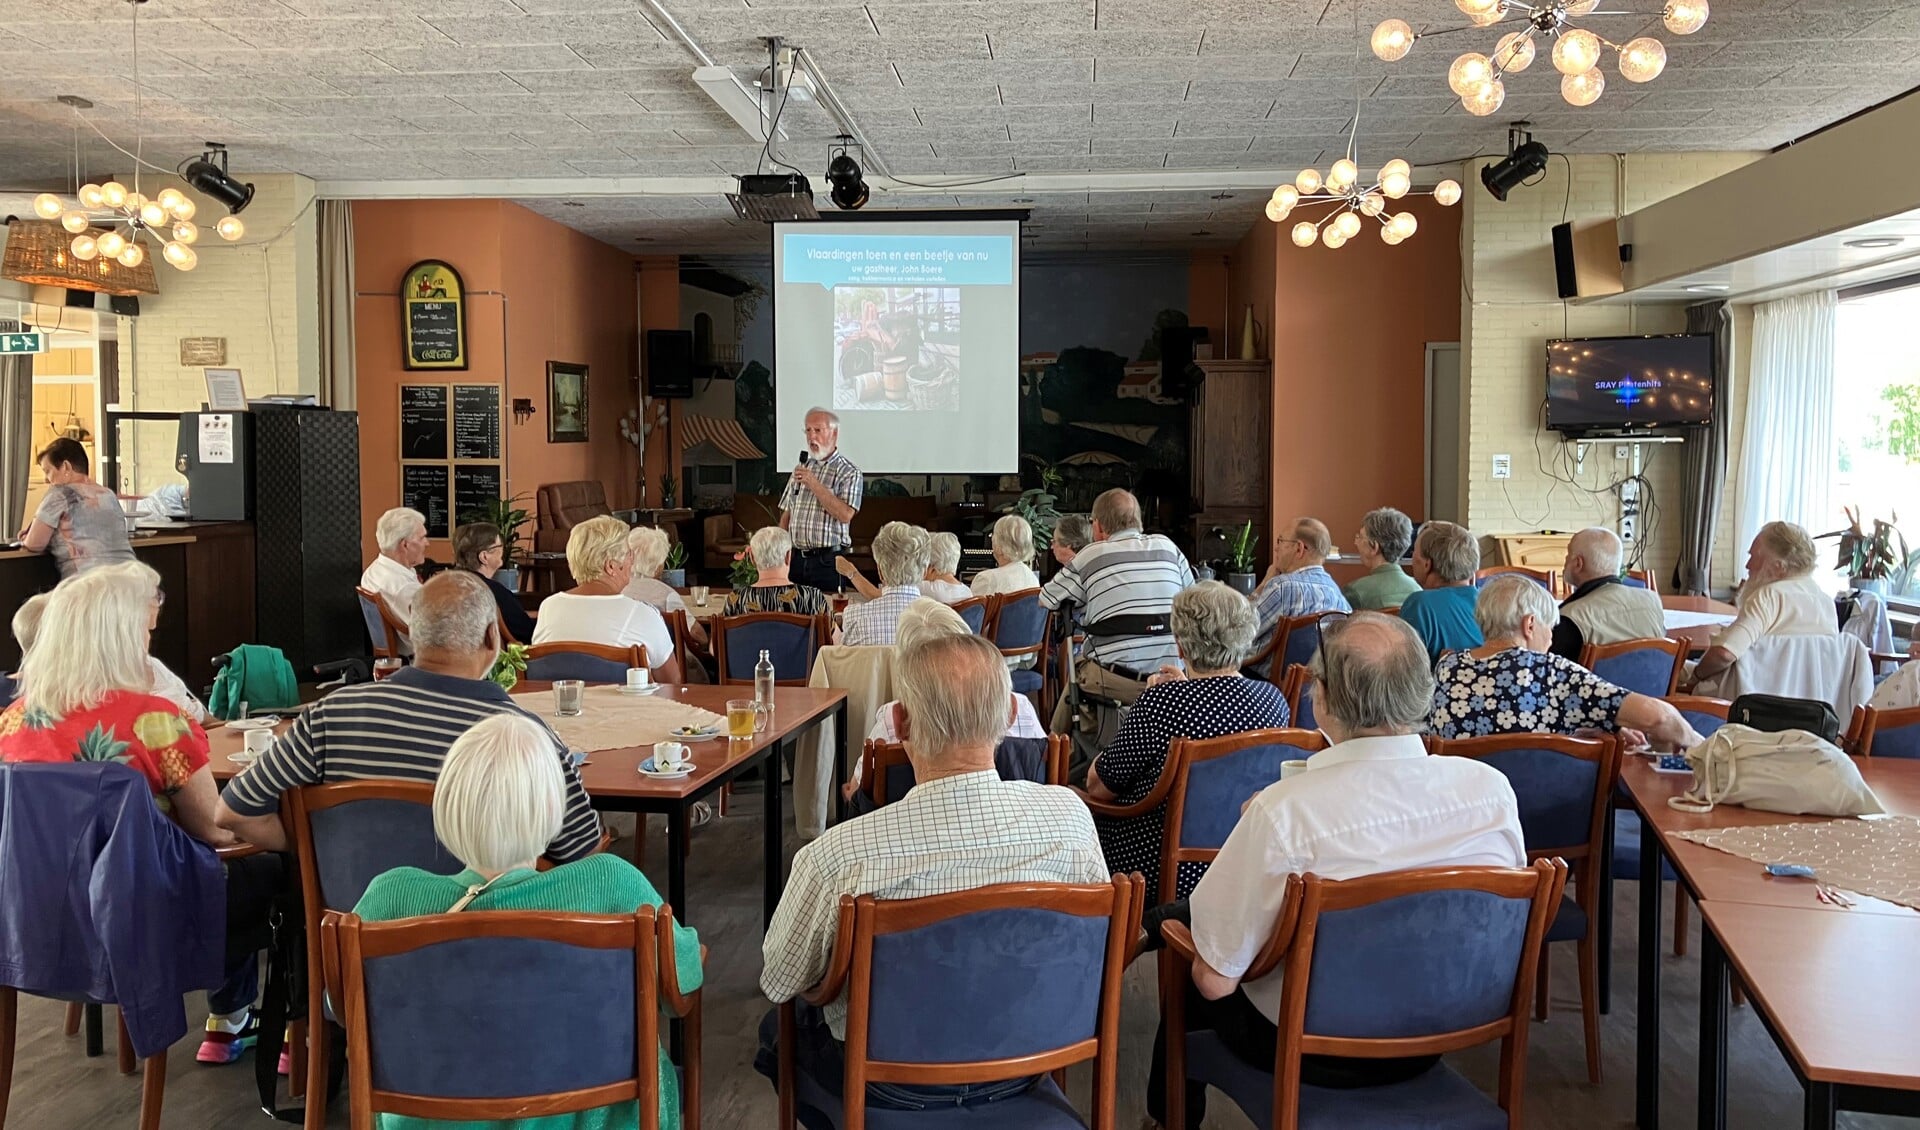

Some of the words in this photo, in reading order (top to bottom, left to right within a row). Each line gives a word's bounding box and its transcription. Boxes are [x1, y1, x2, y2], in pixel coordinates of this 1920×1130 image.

[807, 248, 863, 262] Vlaardingen
[866, 249, 887, 260] toen
[889, 251, 901, 260] en
[904, 251, 922, 261] een
[924, 249, 954, 263] beetje
[957, 251, 974, 261] van
[976, 251, 989, 261] nu
[901, 265, 919, 273] John
[921, 265, 943, 274] Boere
[424, 303, 442, 311] MENU
[1595, 381, 1616, 389] SRAY
